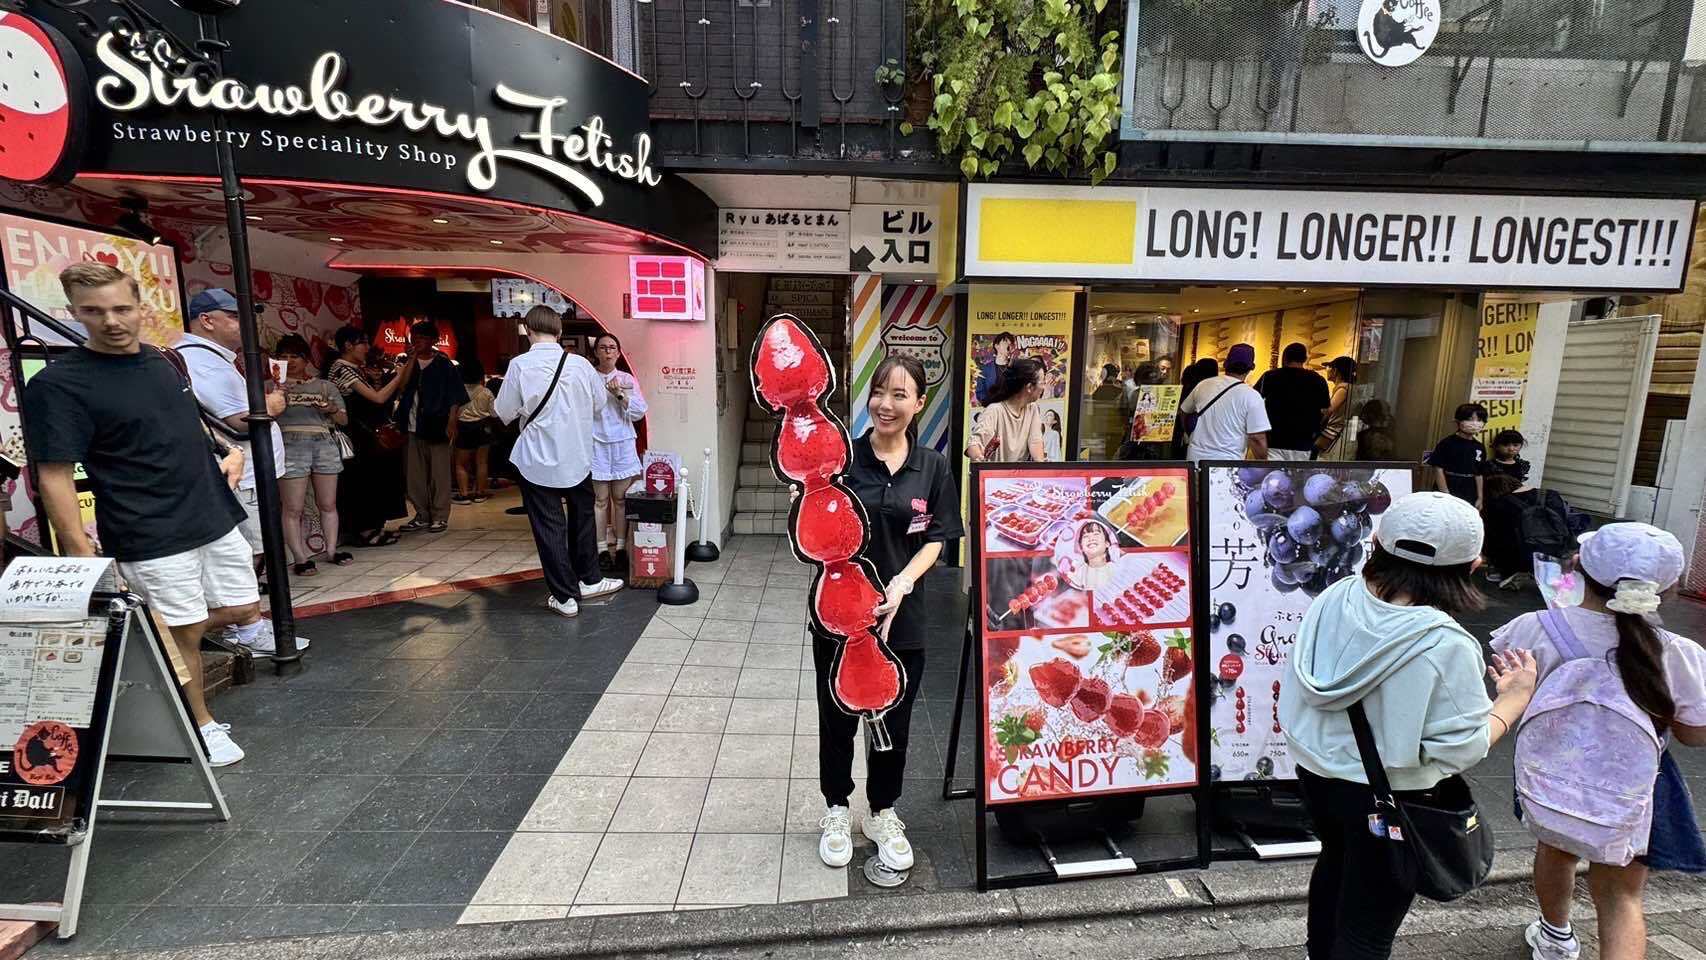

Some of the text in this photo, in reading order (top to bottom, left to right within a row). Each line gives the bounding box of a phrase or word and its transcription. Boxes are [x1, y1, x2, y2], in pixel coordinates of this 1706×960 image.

[96, 28, 663, 206] Strawberry Fetish
[112, 122, 457, 169] Strawberry Speciality Shop
[883, 210, 933, 235] ビル
[1146, 208, 1679, 268] LONG! LONGER!! LONGEST!!!
[880, 239, 931, 264] 入口
[976, 312, 996, 320] LONG!
[998, 312, 1029, 321] LONGER!!
[928, 334, 938, 342] to
[1209, 537, 1259, 591] 芳
[998, 737, 1120, 761] SRAWBERRY
[997, 756, 1120, 795] CANDY
